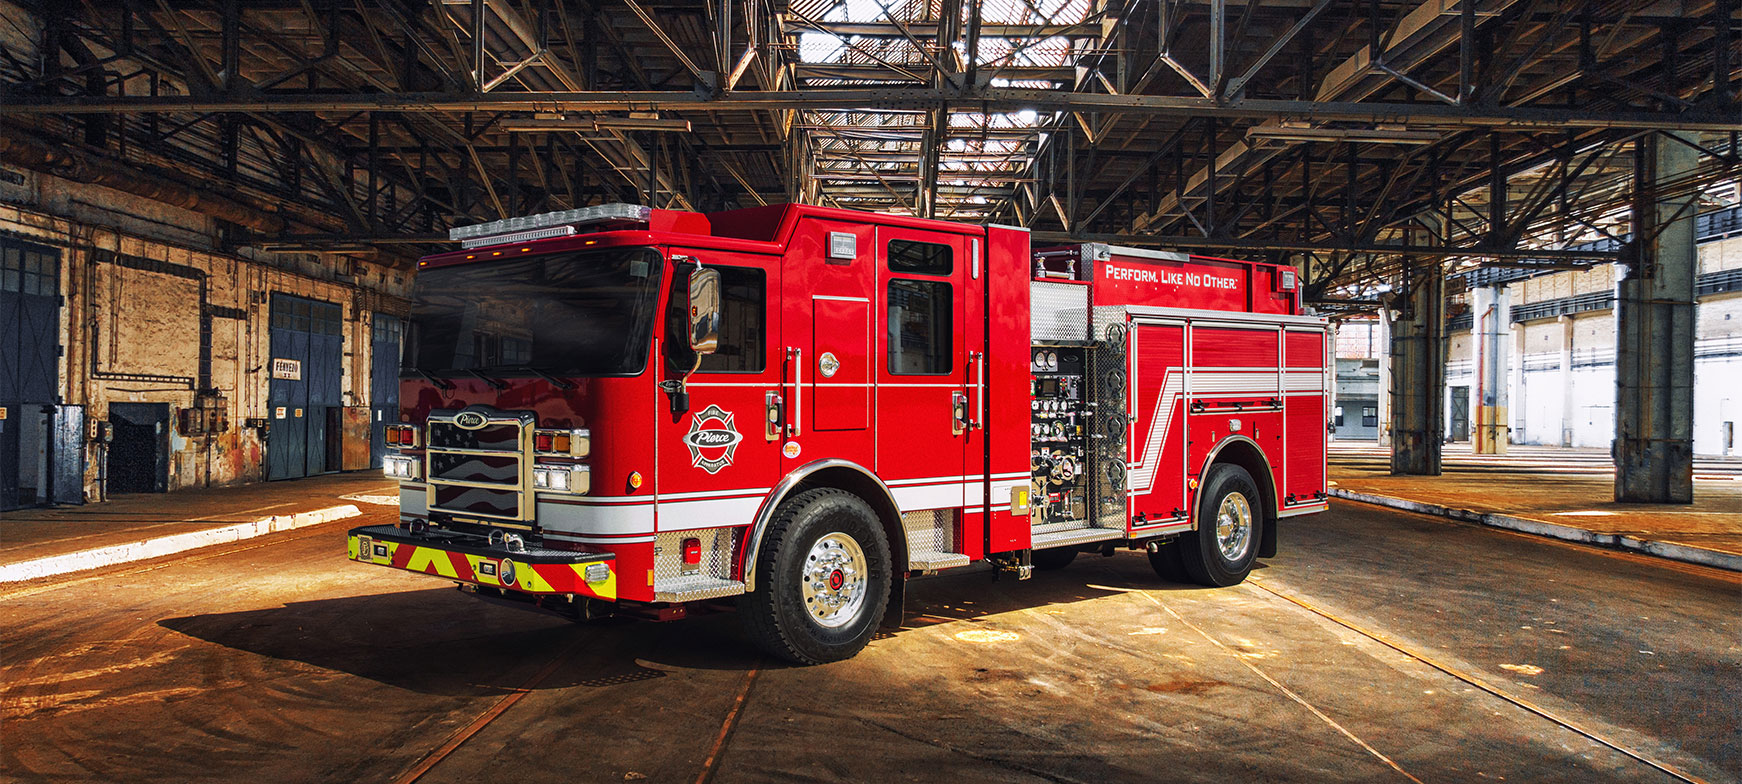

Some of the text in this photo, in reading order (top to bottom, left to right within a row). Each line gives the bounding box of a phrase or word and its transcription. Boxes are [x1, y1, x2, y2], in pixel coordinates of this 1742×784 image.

[1106, 264, 1158, 282] PERFORM.
[1161, 270, 1183, 285] LIKE
[1186, 272, 1200, 287] NO
[460, 414, 480, 425] Pierce
[695, 431, 729, 445] Pierce
